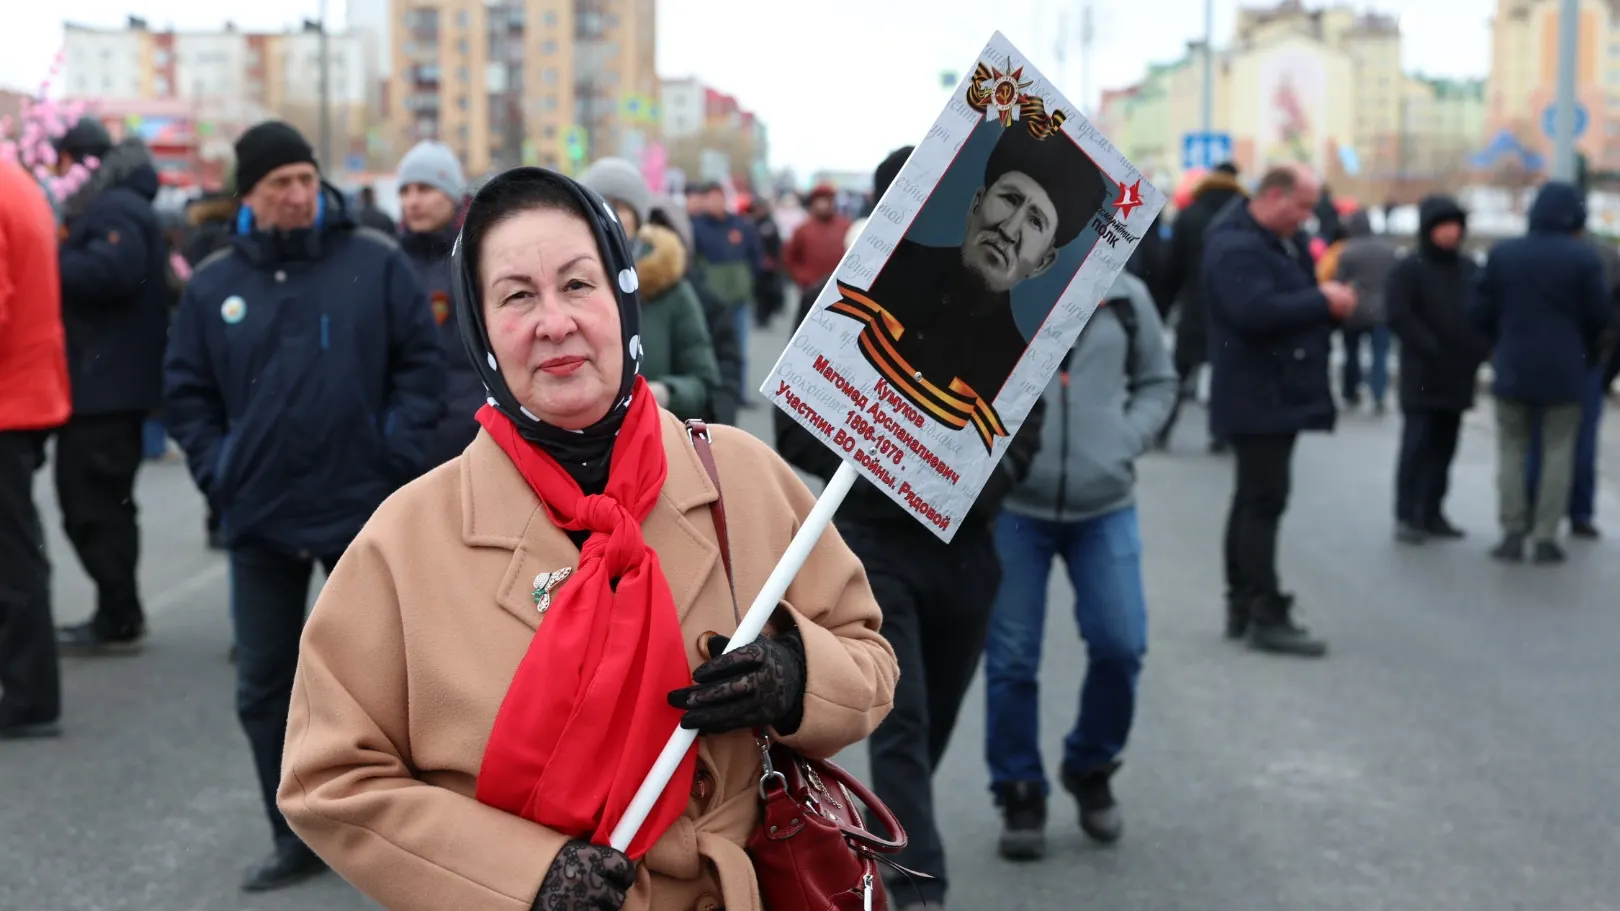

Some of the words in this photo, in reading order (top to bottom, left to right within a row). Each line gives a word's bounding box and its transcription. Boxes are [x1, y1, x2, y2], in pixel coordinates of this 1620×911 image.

[1090, 217, 1119, 248] ПОЛК
[812, 354, 868, 411] Магомед
[866, 402, 959, 483] Арсланалиевич
[874, 377, 924, 427] Кумуков
[775, 380, 834, 434] Участник
[833, 428, 855, 451] ВО
[853, 448, 895, 489] войны.
[899, 481, 950, 531] Рядовой
[847, 410, 904, 464] 1896-1978
